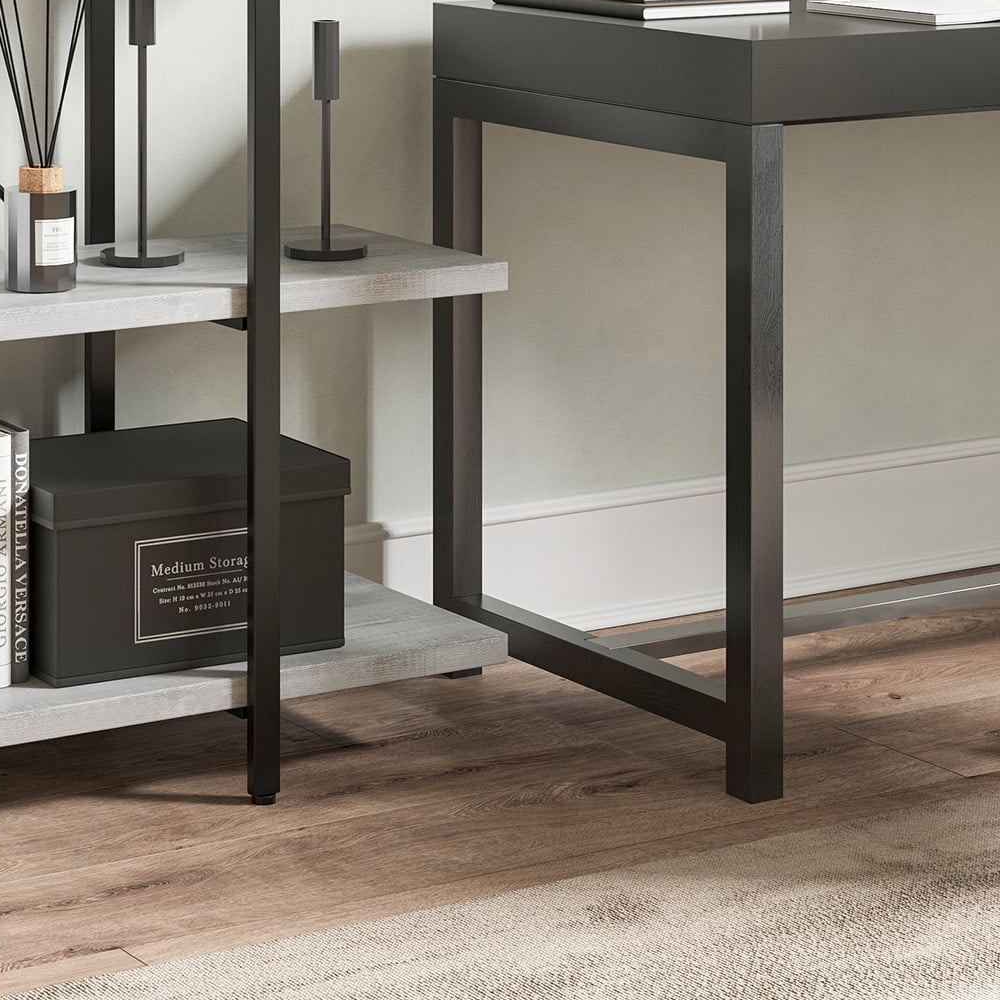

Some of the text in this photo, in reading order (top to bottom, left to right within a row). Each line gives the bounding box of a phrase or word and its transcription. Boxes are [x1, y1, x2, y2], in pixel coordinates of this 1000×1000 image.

[14, 453, 28, 664] DONATELLA VERSACE
[150, 561, 204, 577] Medium
